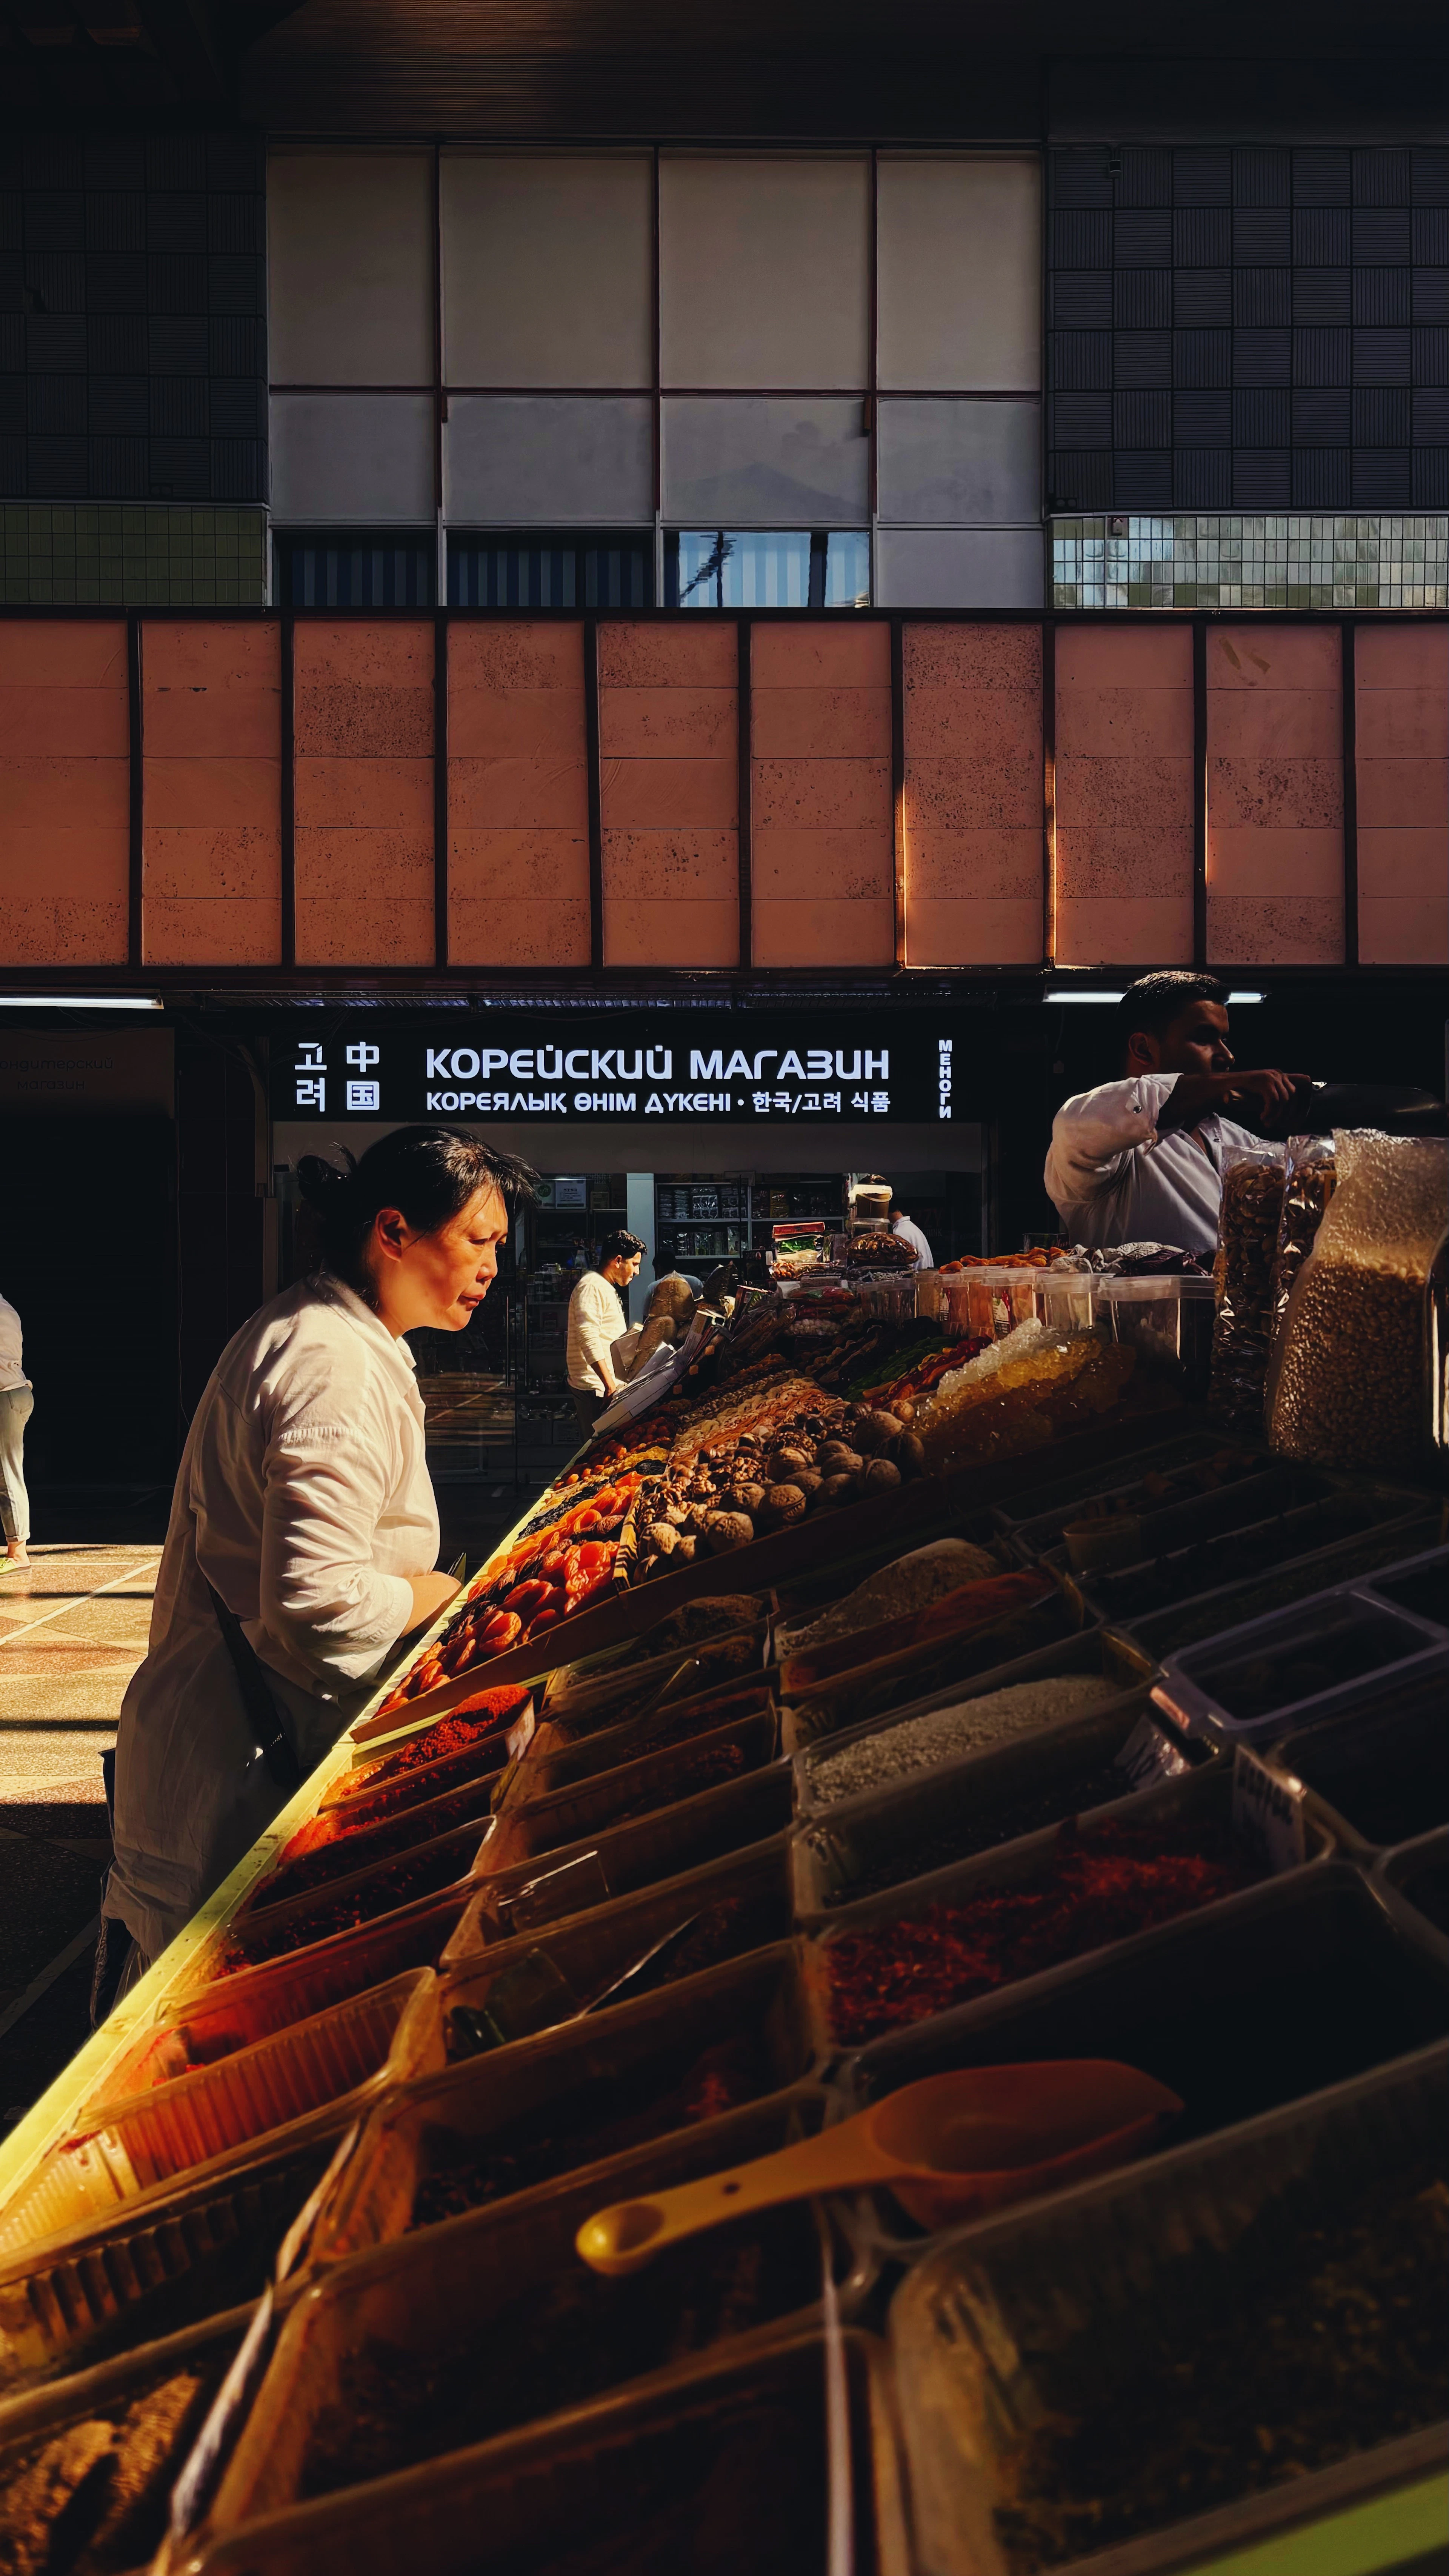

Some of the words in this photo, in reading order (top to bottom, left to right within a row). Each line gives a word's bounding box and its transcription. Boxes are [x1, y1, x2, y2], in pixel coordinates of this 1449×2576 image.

[18, 1080, 85, 1090] магазин
[294, 1043, 327, 1112] 고려
[346, 1041, 380, 1110] 中国
[426, 1044, 672, 1079] КОРЕЙСКИЙ
[690, 1050, 889, 1080] МАГАЗИН
[938, 1040, 952, 1118] МЕНОГИ
[427, 1092, 567, 1113] КОРЕЯЛЫҚ
[574, 1093, 636, 1111] ӨНІМ
[645, 1093, 731, 1113] ДҮКЕНІ
[752, 1091, 841, 1113] 한국/고려
[851, 1092, 891, 1113] 식품
